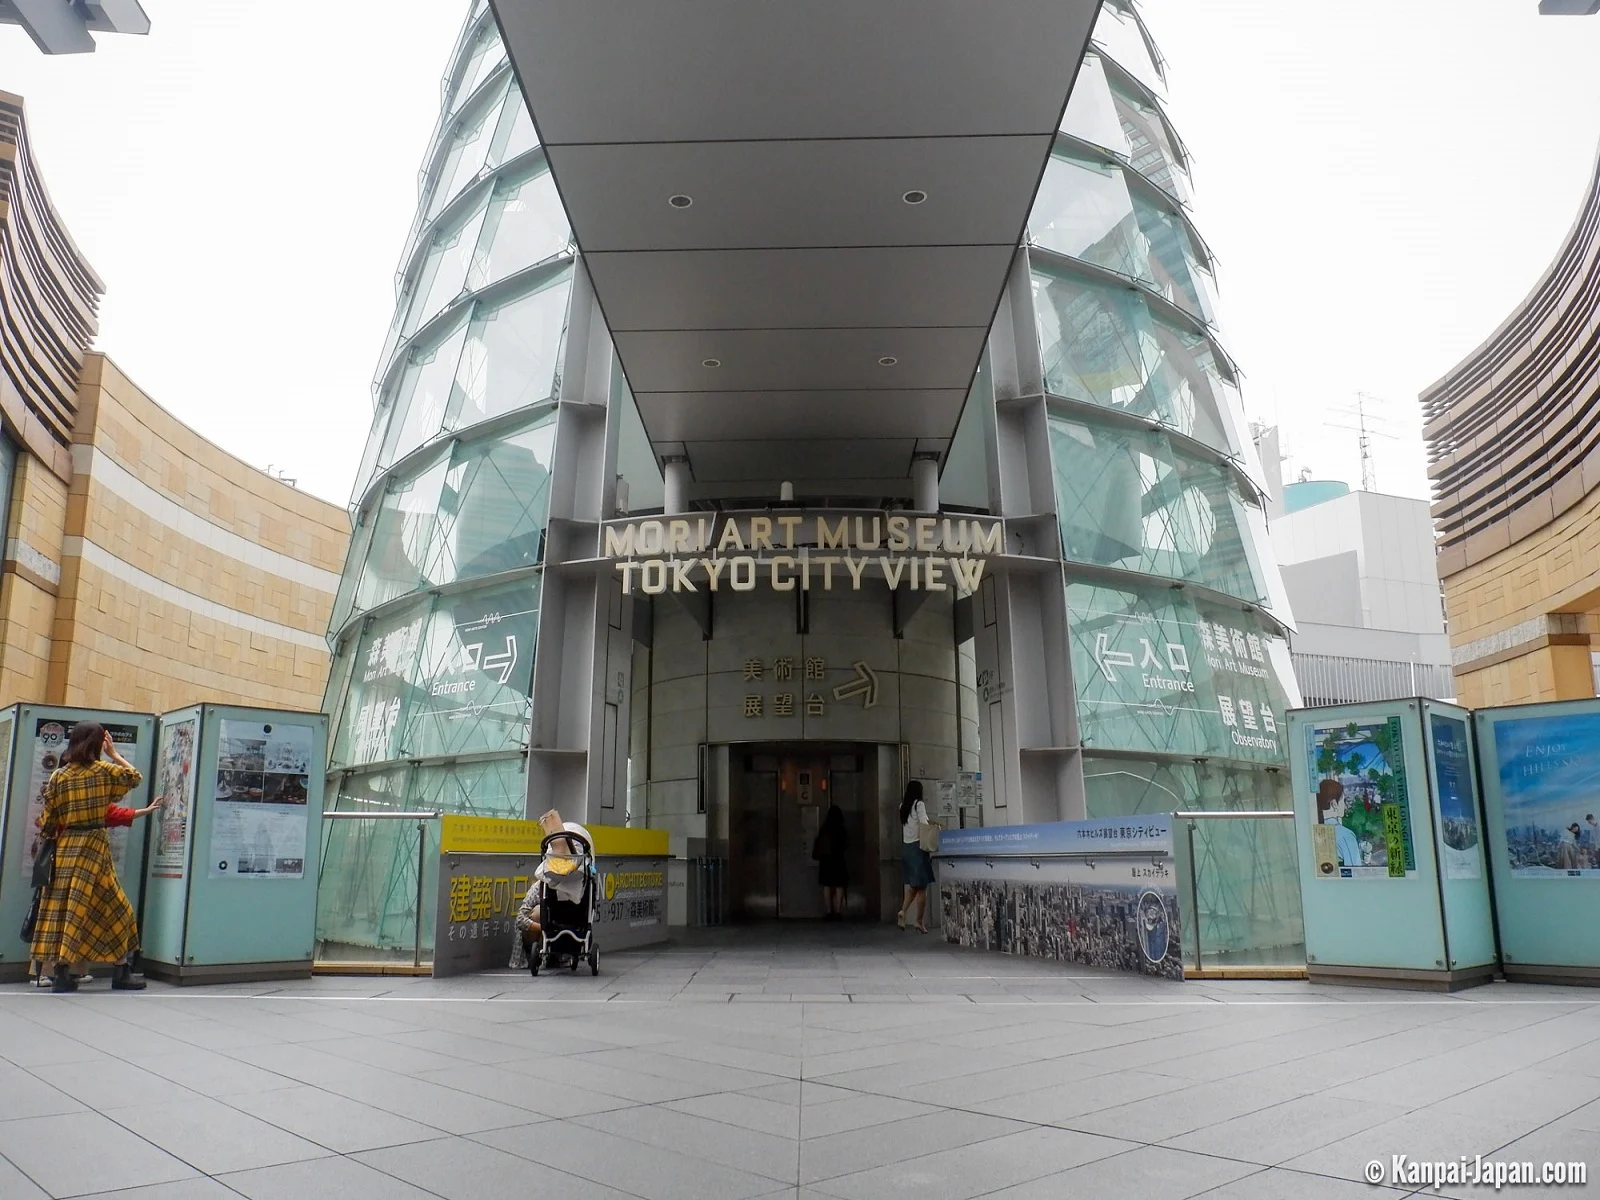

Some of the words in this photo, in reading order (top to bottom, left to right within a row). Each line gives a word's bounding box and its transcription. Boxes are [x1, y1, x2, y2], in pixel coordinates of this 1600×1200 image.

[605, 518, 706, 557] MORI
[717, 516, 803, 552] ART
[817, 516, 1001, 555] MUSEUM
[616, 555, 755, 595] TOKYO
[771, 555, 868, 592] CITY
[879, 556, 986, 594] VIEW
[1199, 619, 1264, 663] 森美術館
[1139, 638, 1190, 672] 入口
[1225, 657, 1237, 673] Art
[1238, 661, 1269, 679] Museum
[743, 656, 825, 682] 美術館
[431, 680, 476, 696] Entrance
[1142, 673, 1195, 692] Entrance
[743, 694, 825, 717] 展望台
[1217, 695, 1276, 734] 展望台
[1231, 728, 1277, 755] Observatory
[1526, 744, 1567, 757] ENJOY
[1119, 824, 1167, 839] 東京シティビュー
[615, 872, 663, 890] ARCHITECTURE
[449, 874, 535, 924] 建築の日
